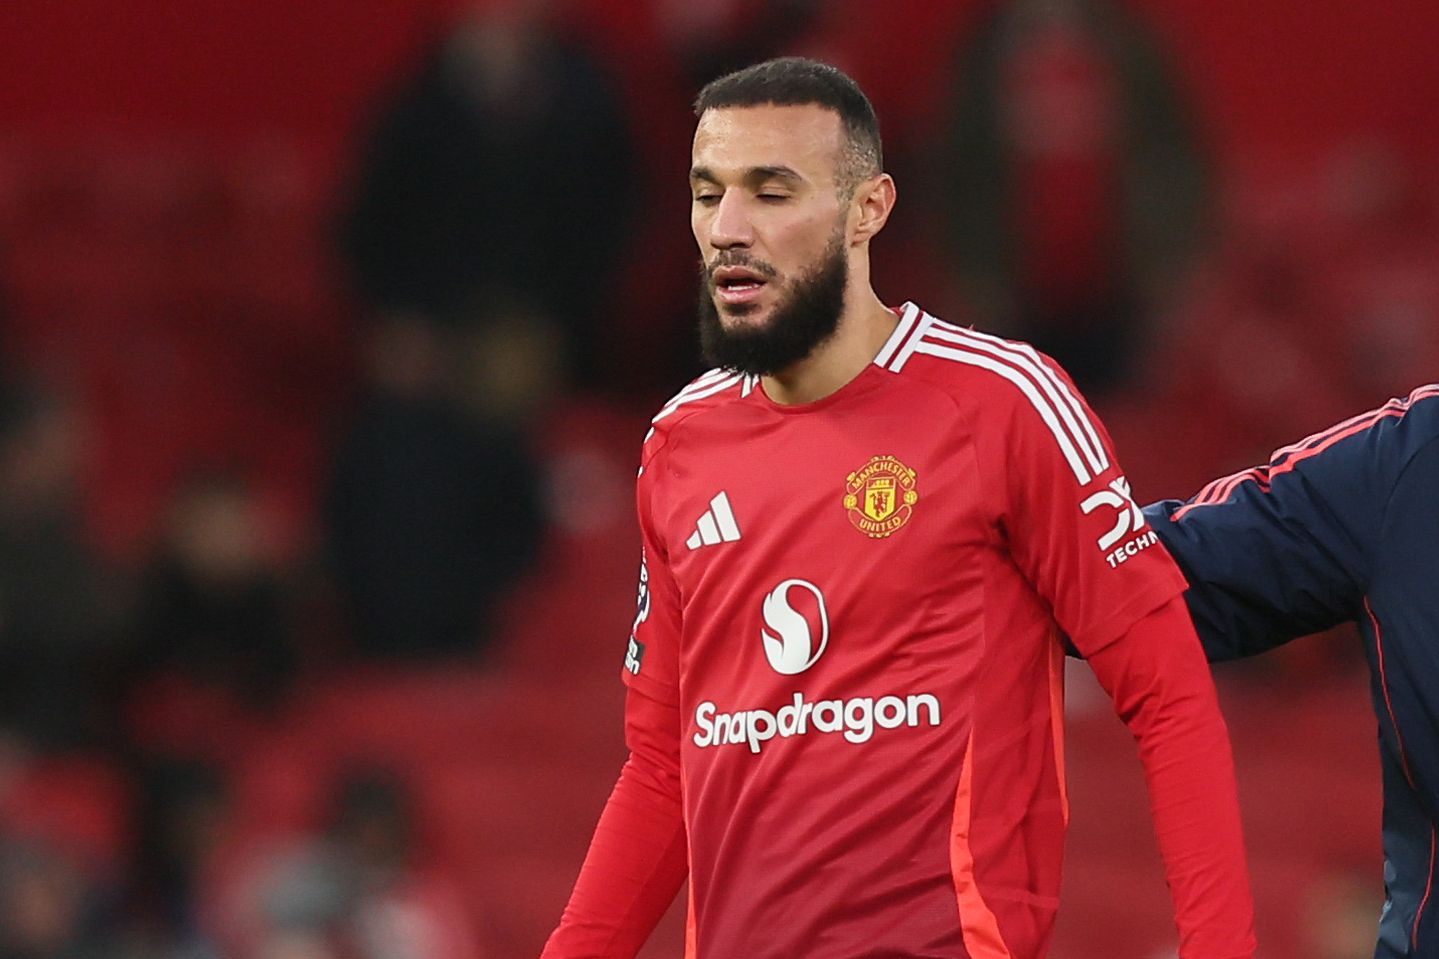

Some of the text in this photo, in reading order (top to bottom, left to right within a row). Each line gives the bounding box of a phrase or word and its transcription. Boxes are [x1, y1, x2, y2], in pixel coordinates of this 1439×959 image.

[852, 461, 911, 489] MANCHESTER
[860, 517, 902, 532] UNITED
[694, 693, 940, 753] Snapdragon
